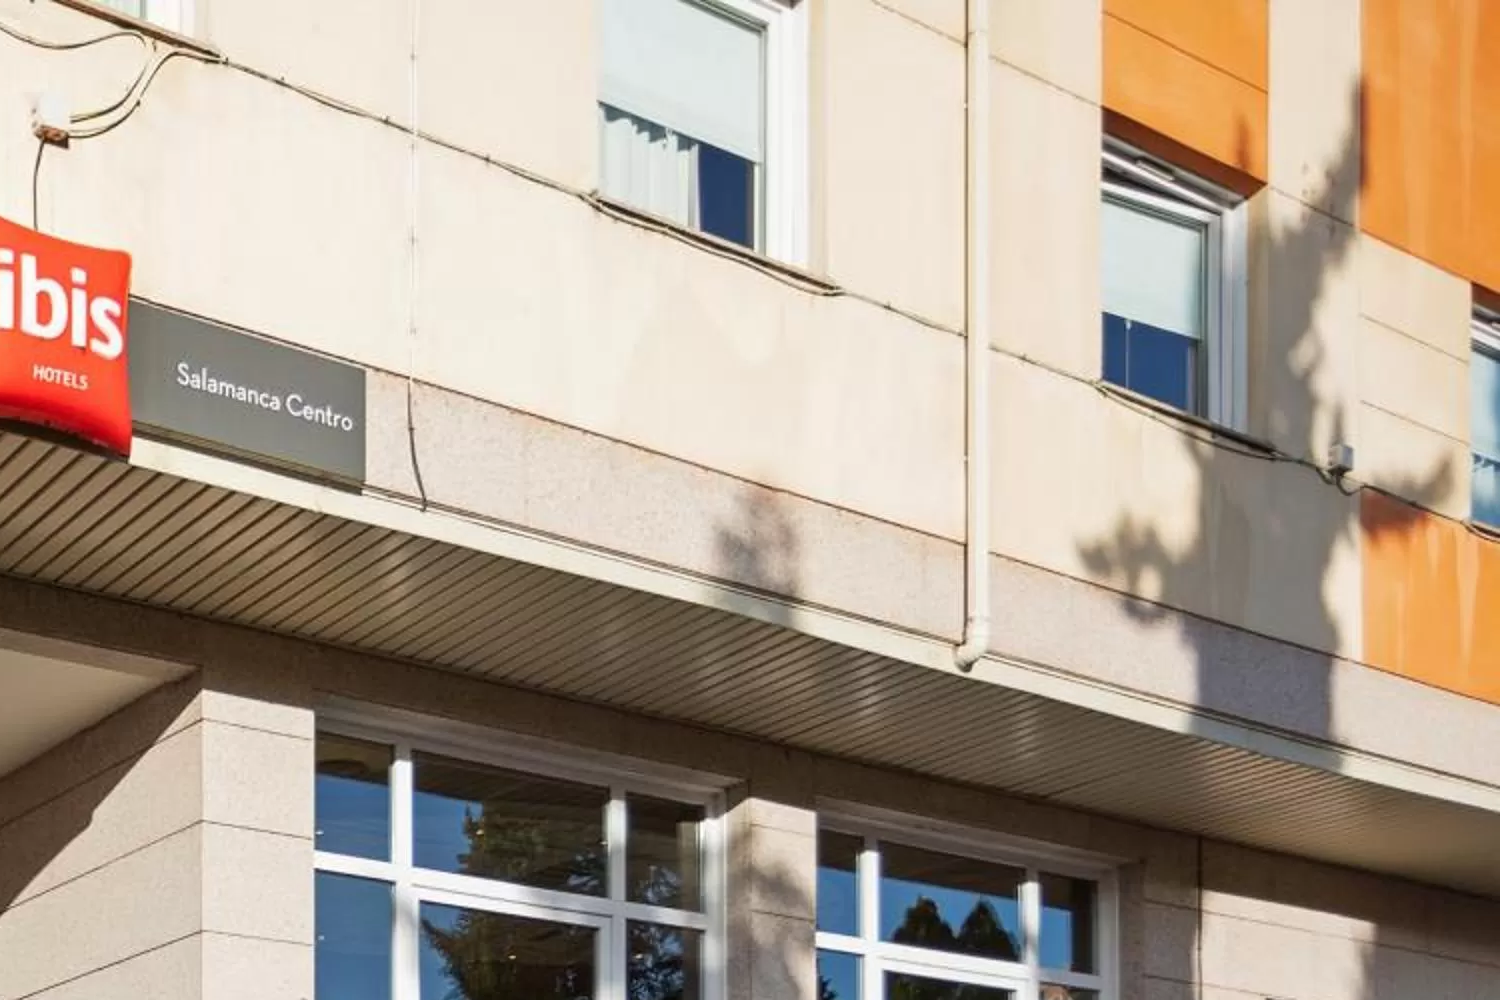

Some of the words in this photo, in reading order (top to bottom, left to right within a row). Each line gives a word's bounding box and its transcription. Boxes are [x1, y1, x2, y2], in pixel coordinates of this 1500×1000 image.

[33, 364, 88, 390] HOTELS
[177, 361, 281, 411] Salamanca
[285, 394, 354, 432] Centro
